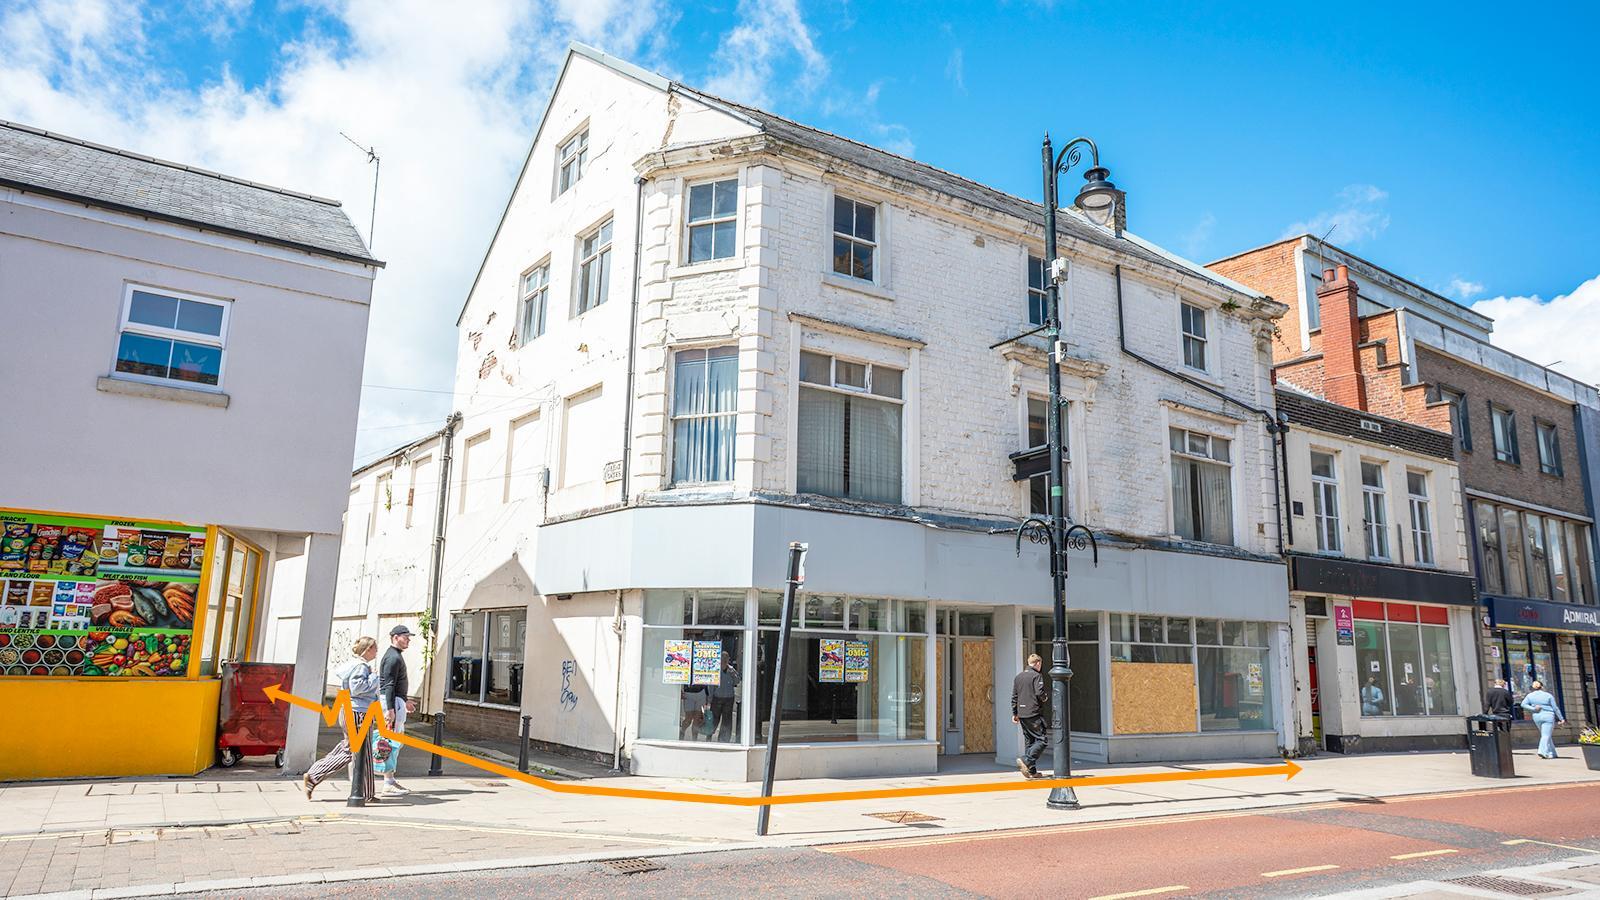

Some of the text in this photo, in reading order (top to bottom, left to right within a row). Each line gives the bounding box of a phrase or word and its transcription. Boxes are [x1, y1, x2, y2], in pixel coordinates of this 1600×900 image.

[1563, 608, 1600, 626] ADMIRAL
[696, 650, 717, 658] OMG
[847, 649, 866, 657] OMG
